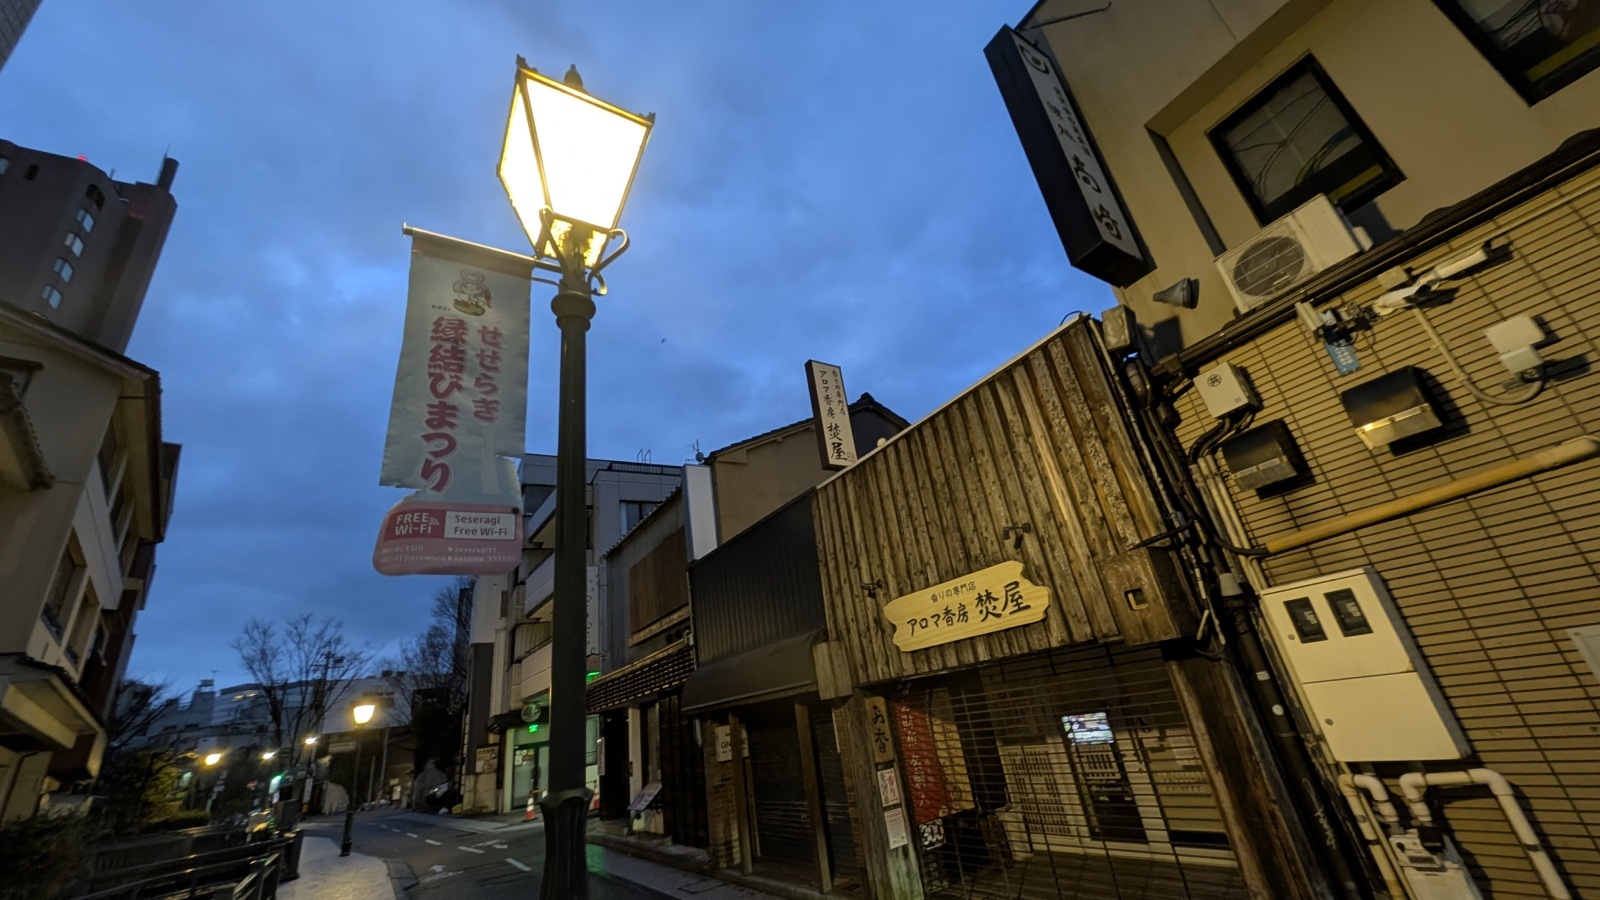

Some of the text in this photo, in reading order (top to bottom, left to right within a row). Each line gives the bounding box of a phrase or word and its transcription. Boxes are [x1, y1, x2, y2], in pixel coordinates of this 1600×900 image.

[471, 325, 504, 423] せせらぎ
[419, 315, 471, 494] 縁結びまつり
[819, 370, 848, 461] アロマ香房 焚屋
[395, 523, 432, 536] Wi-Fi
[396, 512, 430, 525] FREE
[454, 526, 508, 537] Free Wi-Fi
[455, 514, 501, 526] Seseragi
[906, 580, 1032, 637] アロマ香房 焚屋
[930, 581, 977, 603] 香りの専門店
[872, 704, 890, 753] お香
